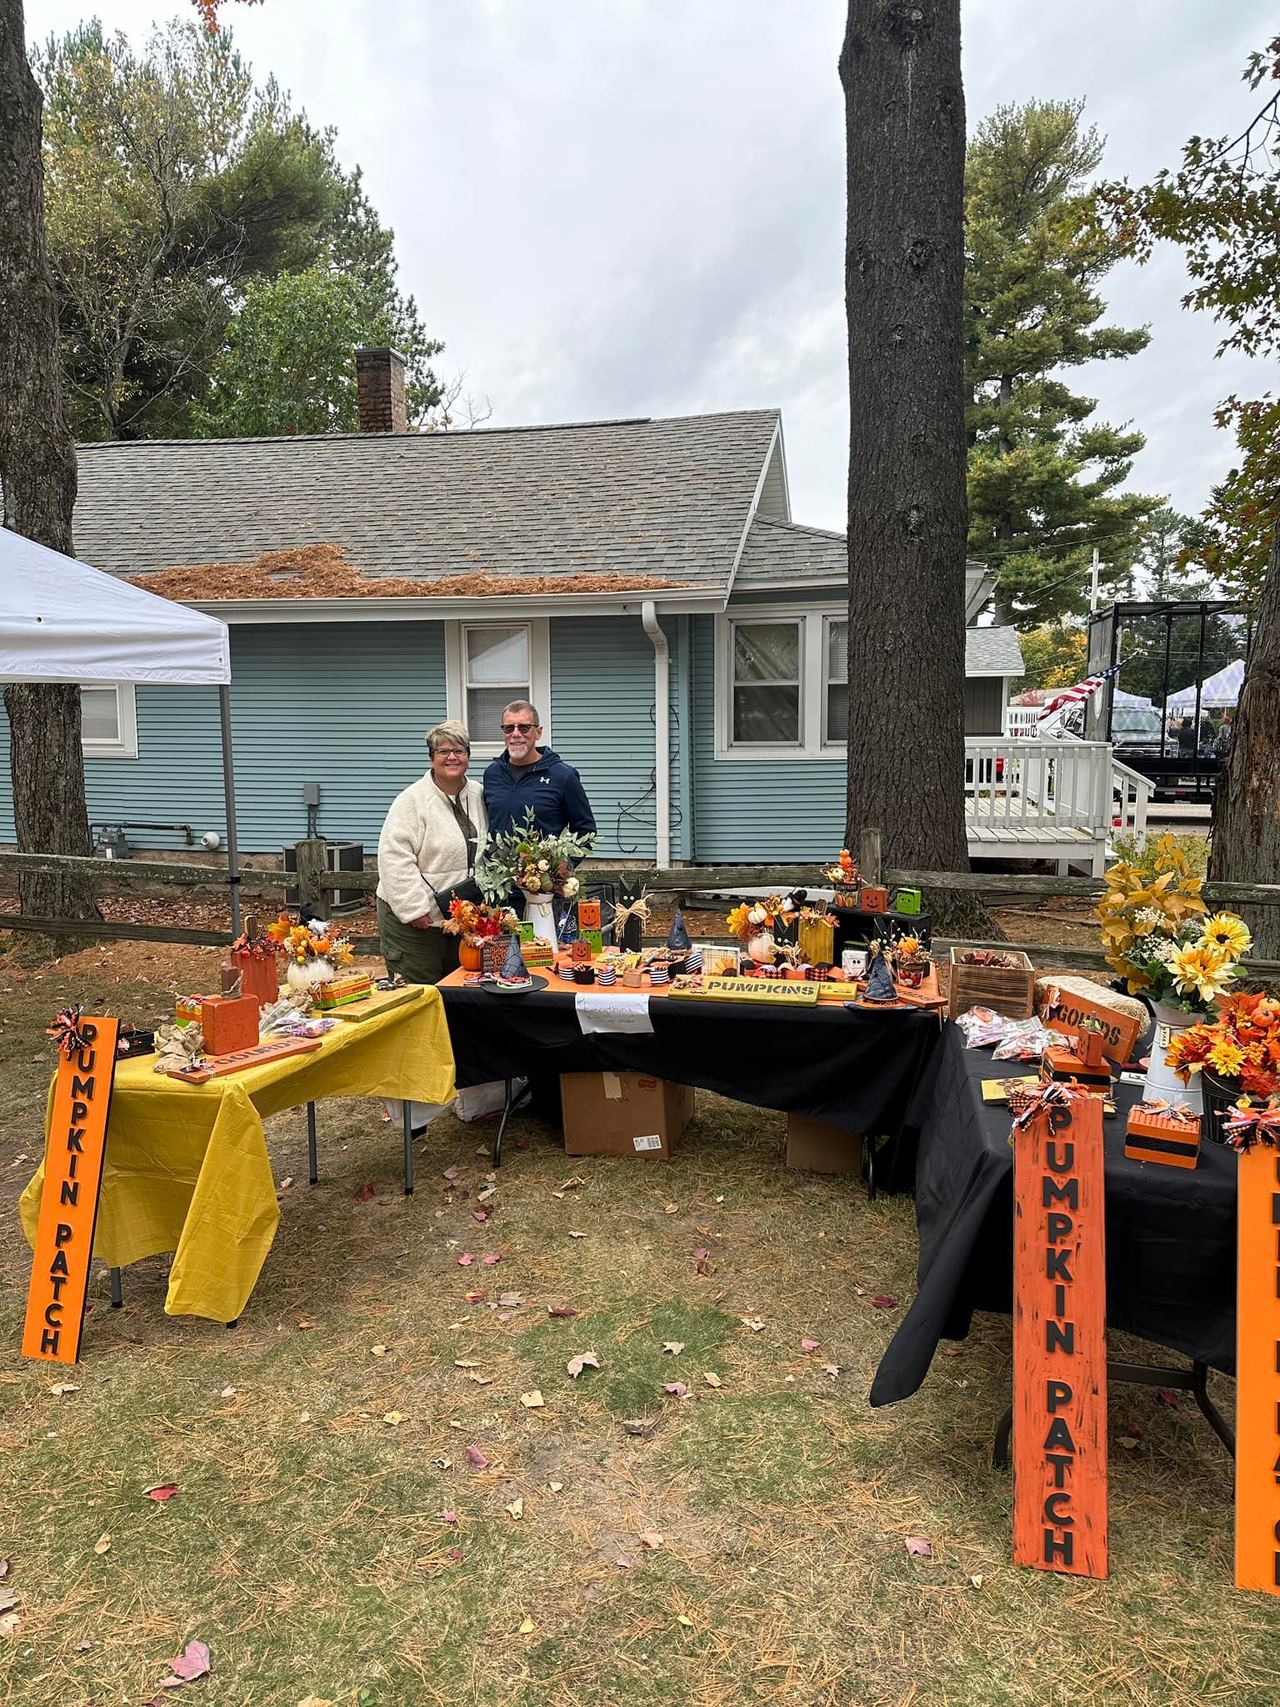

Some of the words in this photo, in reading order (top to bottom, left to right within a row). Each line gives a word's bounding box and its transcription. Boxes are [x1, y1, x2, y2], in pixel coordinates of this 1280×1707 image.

[707, 980, 815, 996] PUMPKINS
[60, 1022, 97, 1206] PUMPKIN
[40, 1223, 73, 1356] PATCH
[1042, 1106, 1079, 1355] PUMPKIN
[1043, 1380, 1075, 1566] PATCH
